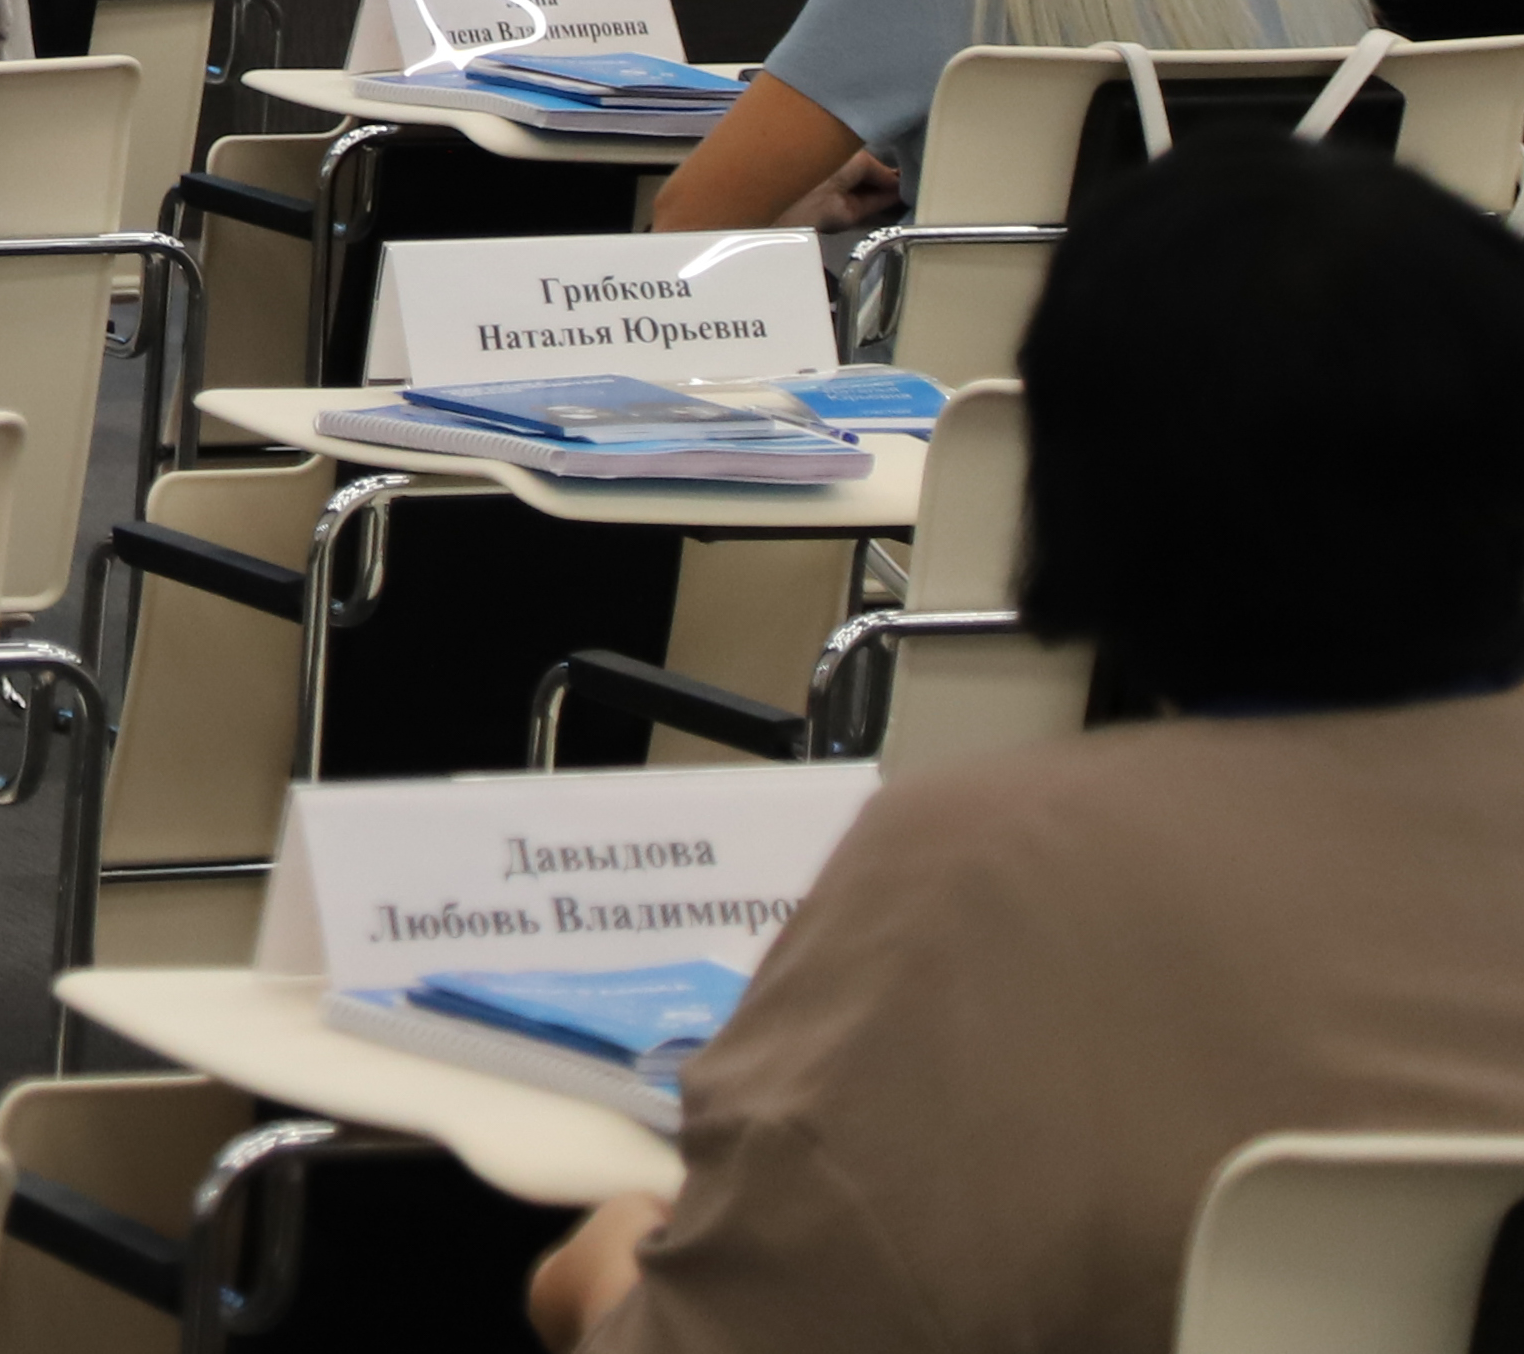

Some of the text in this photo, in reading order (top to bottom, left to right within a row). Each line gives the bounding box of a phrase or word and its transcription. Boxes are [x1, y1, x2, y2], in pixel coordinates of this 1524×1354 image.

[539, 274, 693, 312] Грибкова
[477, 315, 769, 352] Наталья Юрьевна
[503, 836, 717, 881] Давыдова
[368, 900, 541, 944] Любовь
